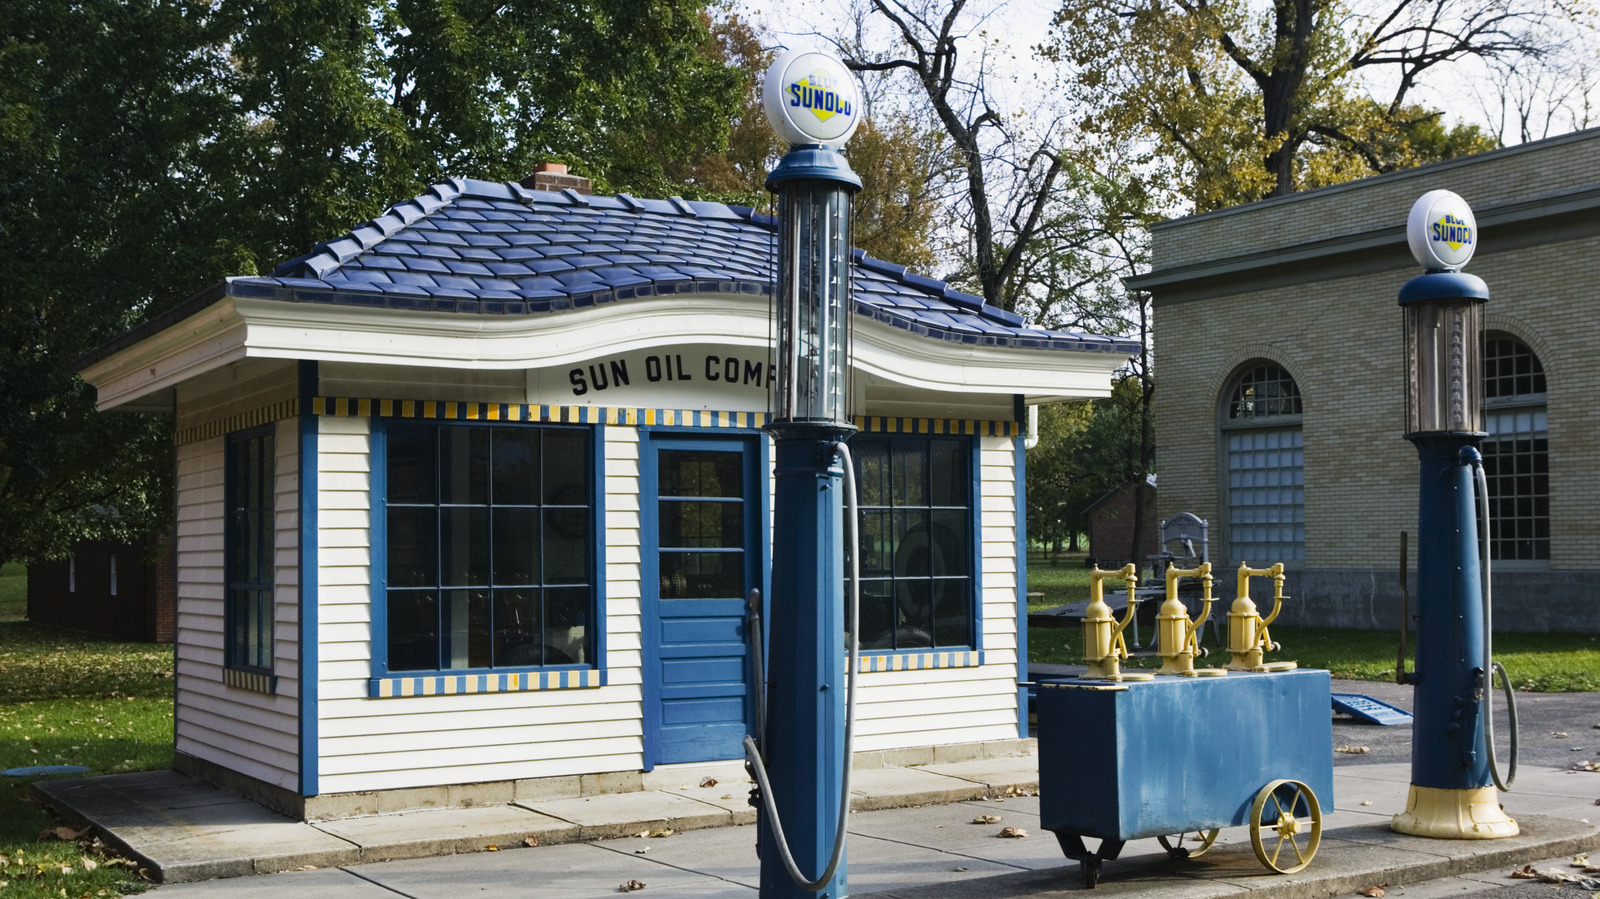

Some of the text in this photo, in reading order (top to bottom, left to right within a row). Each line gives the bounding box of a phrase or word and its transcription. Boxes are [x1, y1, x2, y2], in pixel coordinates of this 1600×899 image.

[790, 83, 852, 116] SUNOCO
[1433, 222, 1473, 245] SUNOCO
[1445, 214, 1465, 225] BLUE
[569, 358, 630, 396] SUN
[645, 354, 692, 382] OIL
